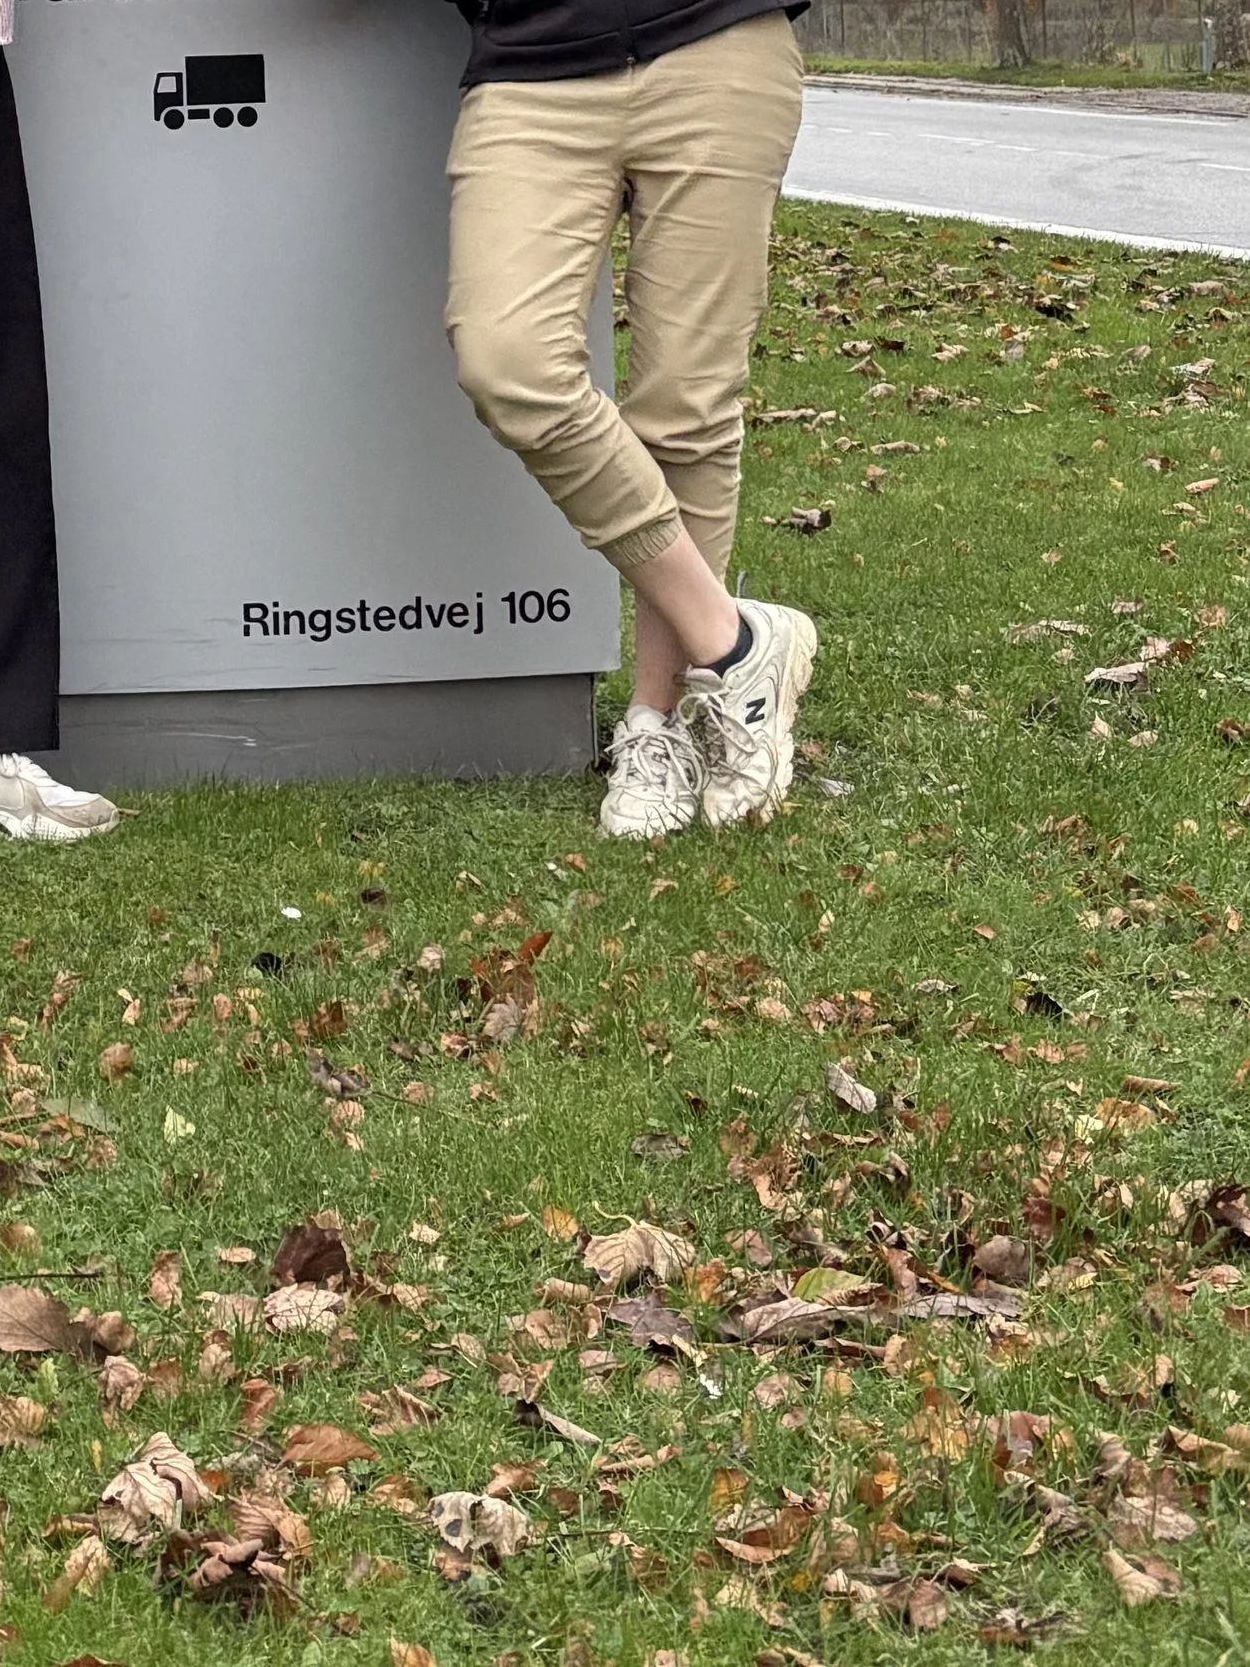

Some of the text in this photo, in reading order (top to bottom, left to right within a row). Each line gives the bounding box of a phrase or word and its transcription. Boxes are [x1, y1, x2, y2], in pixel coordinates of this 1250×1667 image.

[243, 588, 571, 642] Ringstedvej 106
[745, 697, 766, 725] N
